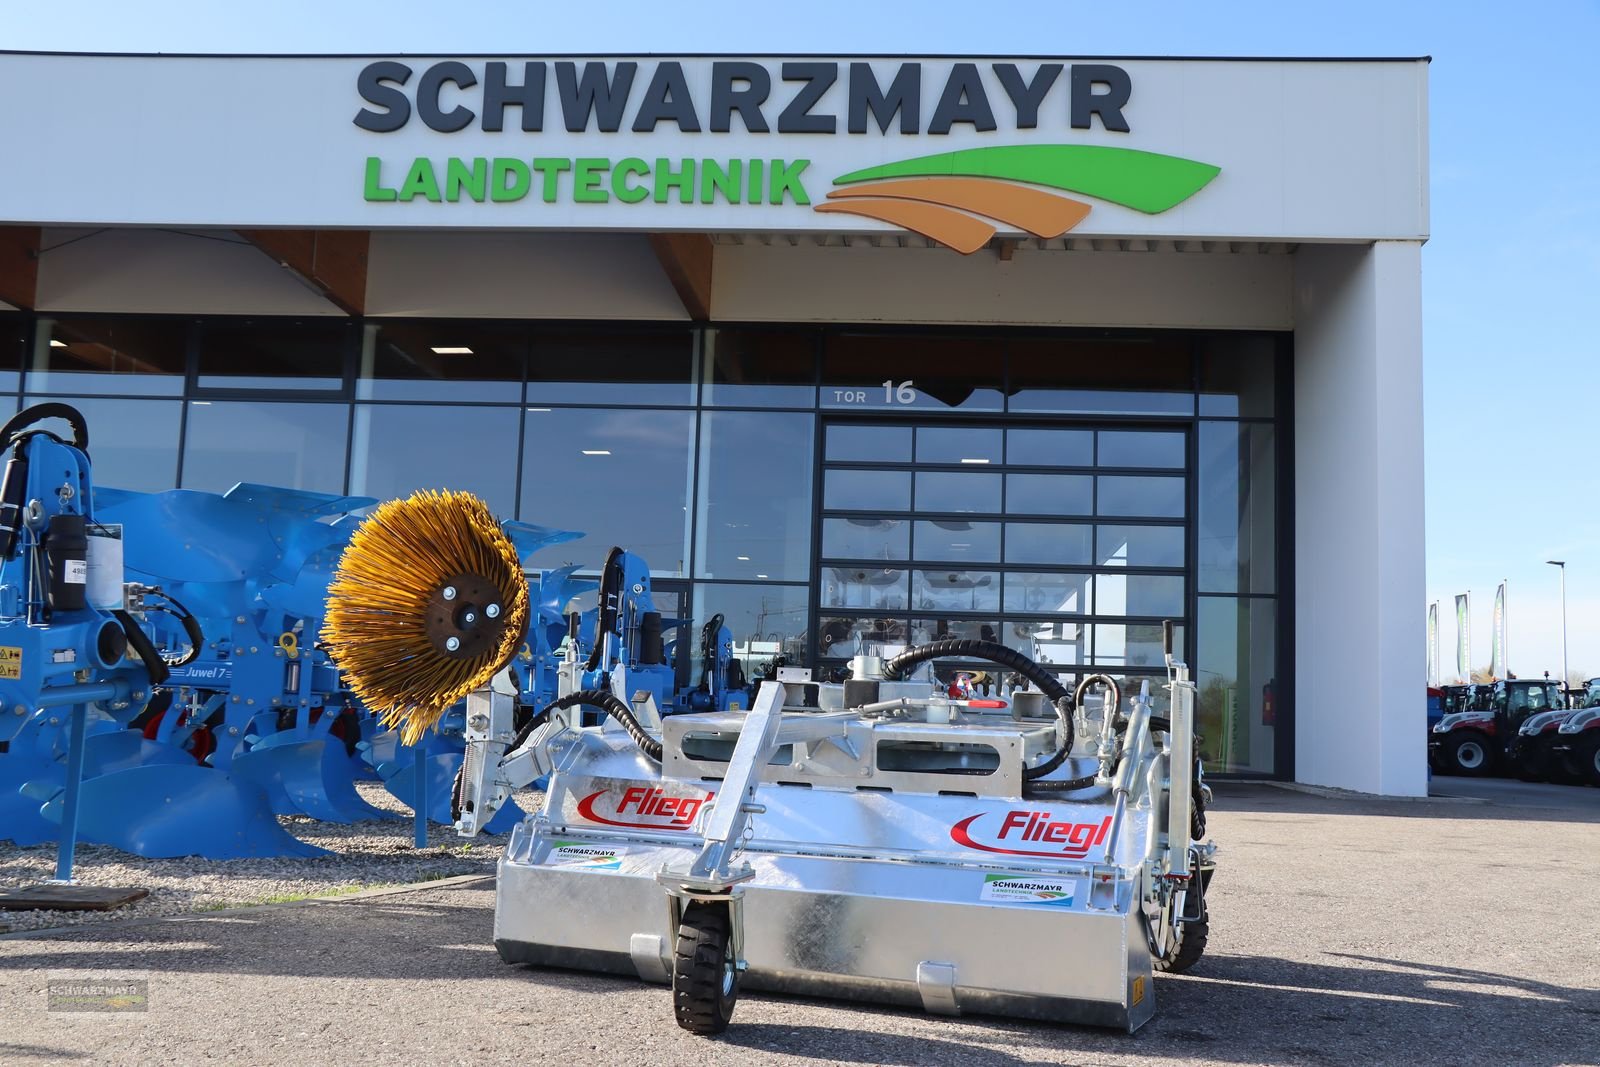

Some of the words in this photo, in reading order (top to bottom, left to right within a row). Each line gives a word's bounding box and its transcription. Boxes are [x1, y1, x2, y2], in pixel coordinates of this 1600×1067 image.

[353, 61, 1132, 136] SCHWARZMAYR
[364, 157, 811, 205] LANDTECHNIK
[834, 391, 866, 403] TOR
[882, 380, 916, 404] 16
[186, 667, 217, 678] Juwel
[218, 668, 226, 678] 7
[997, 811, 1113, 852] Fliegl
[558, 847, 616, 856] SCHWARZMAYR
[992, 881, 1062, 892] SCHWARZMAYR
